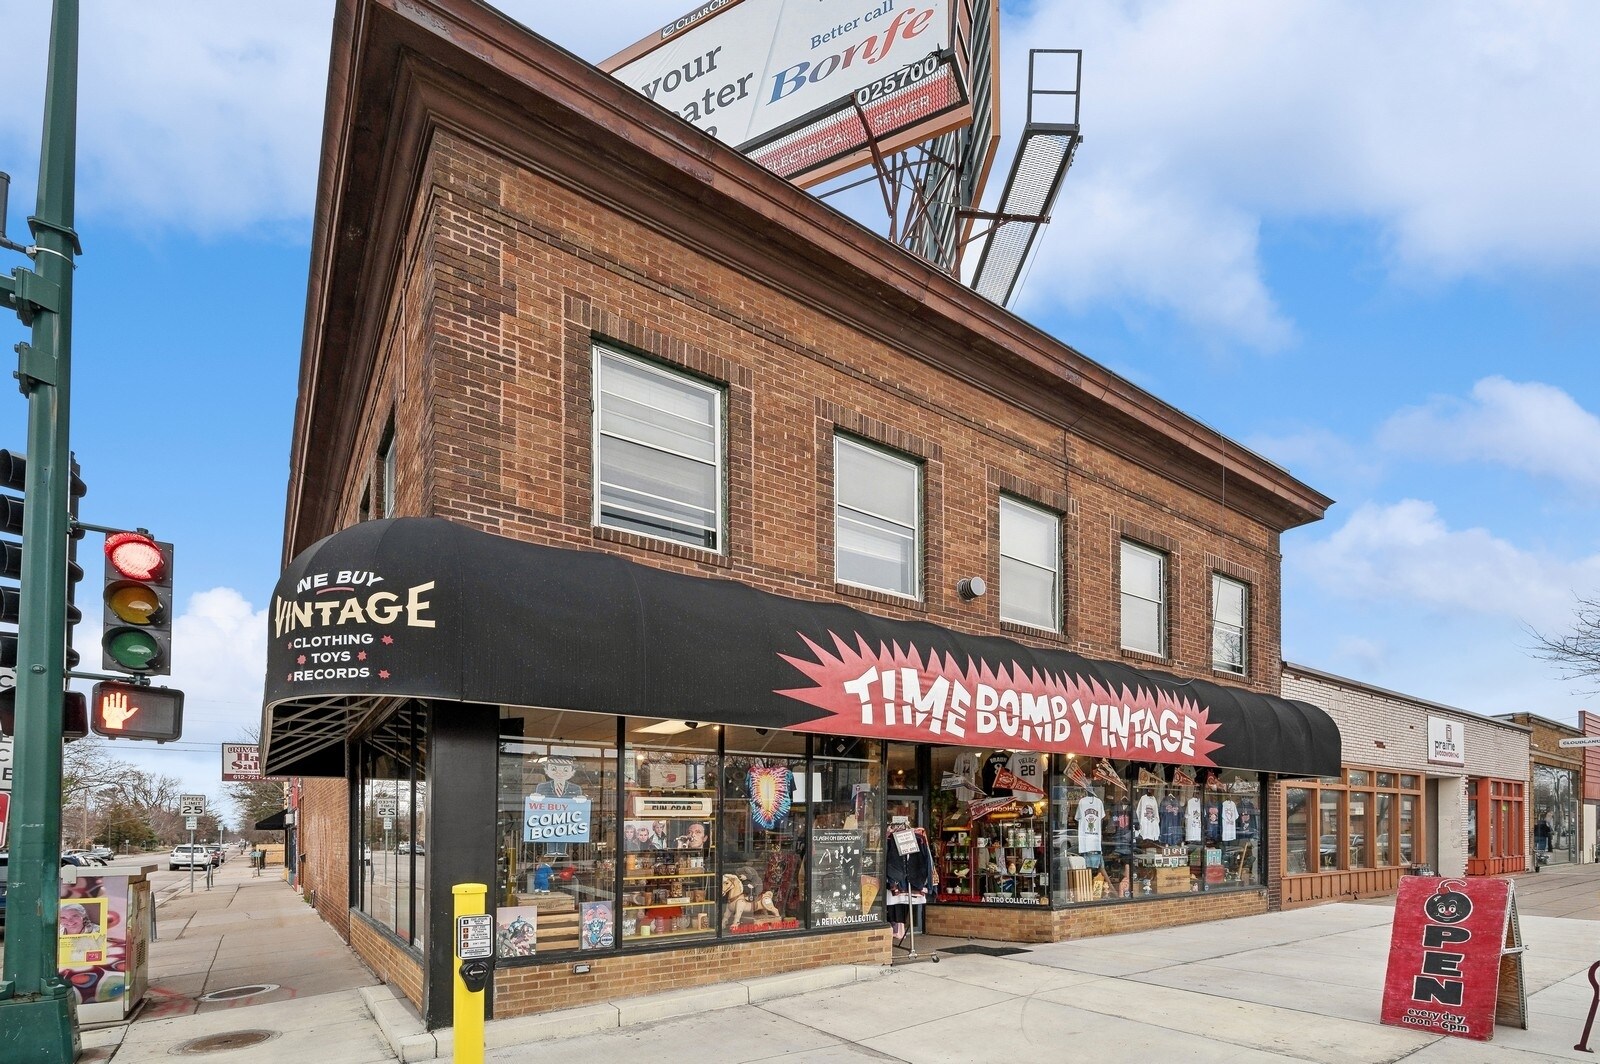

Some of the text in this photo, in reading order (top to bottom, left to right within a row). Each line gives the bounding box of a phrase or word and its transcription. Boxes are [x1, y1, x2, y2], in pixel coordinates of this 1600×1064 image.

[676, 7, 709, 30] CLEAR
[811, 0, 894, 50] Better call
[766, 7, 935, 106] Bonfe
[641, 46, 722, 101] your
[857, 56, 938, 106] 025700
[873, 95, 930, 127] SEWER
[297, 570, 384, 594] WE BUY
[275, 580, 436, 639] VINTAGE
[294, 633, 374, 649] CLOTHING
[311, 651, 351, 664] TOYS
[293, 667, 370, 682] RECORDS
[843, 665, 1198, 757] TIME BOMB VINTAGE
[231, 761, 260, 770] Sal
[1020, 765, 1036, 776] 28
[182, 805, 203, 814] 25
[529, 802, 569, 811] WE BUY
[527, 811, 583, 828] COMIC
[530, 822, 588, 841] BOOKS
[1005, 897, 1040, 905] COLLECTIVE
[815, 913, 879, 927] A RETRO COLLECTIVE
[1402, 1015, 1431, 1027] noon
[1441, 1020, 1469, 1034] 6pm
[1407, 1008, 1466, 1024] every day
